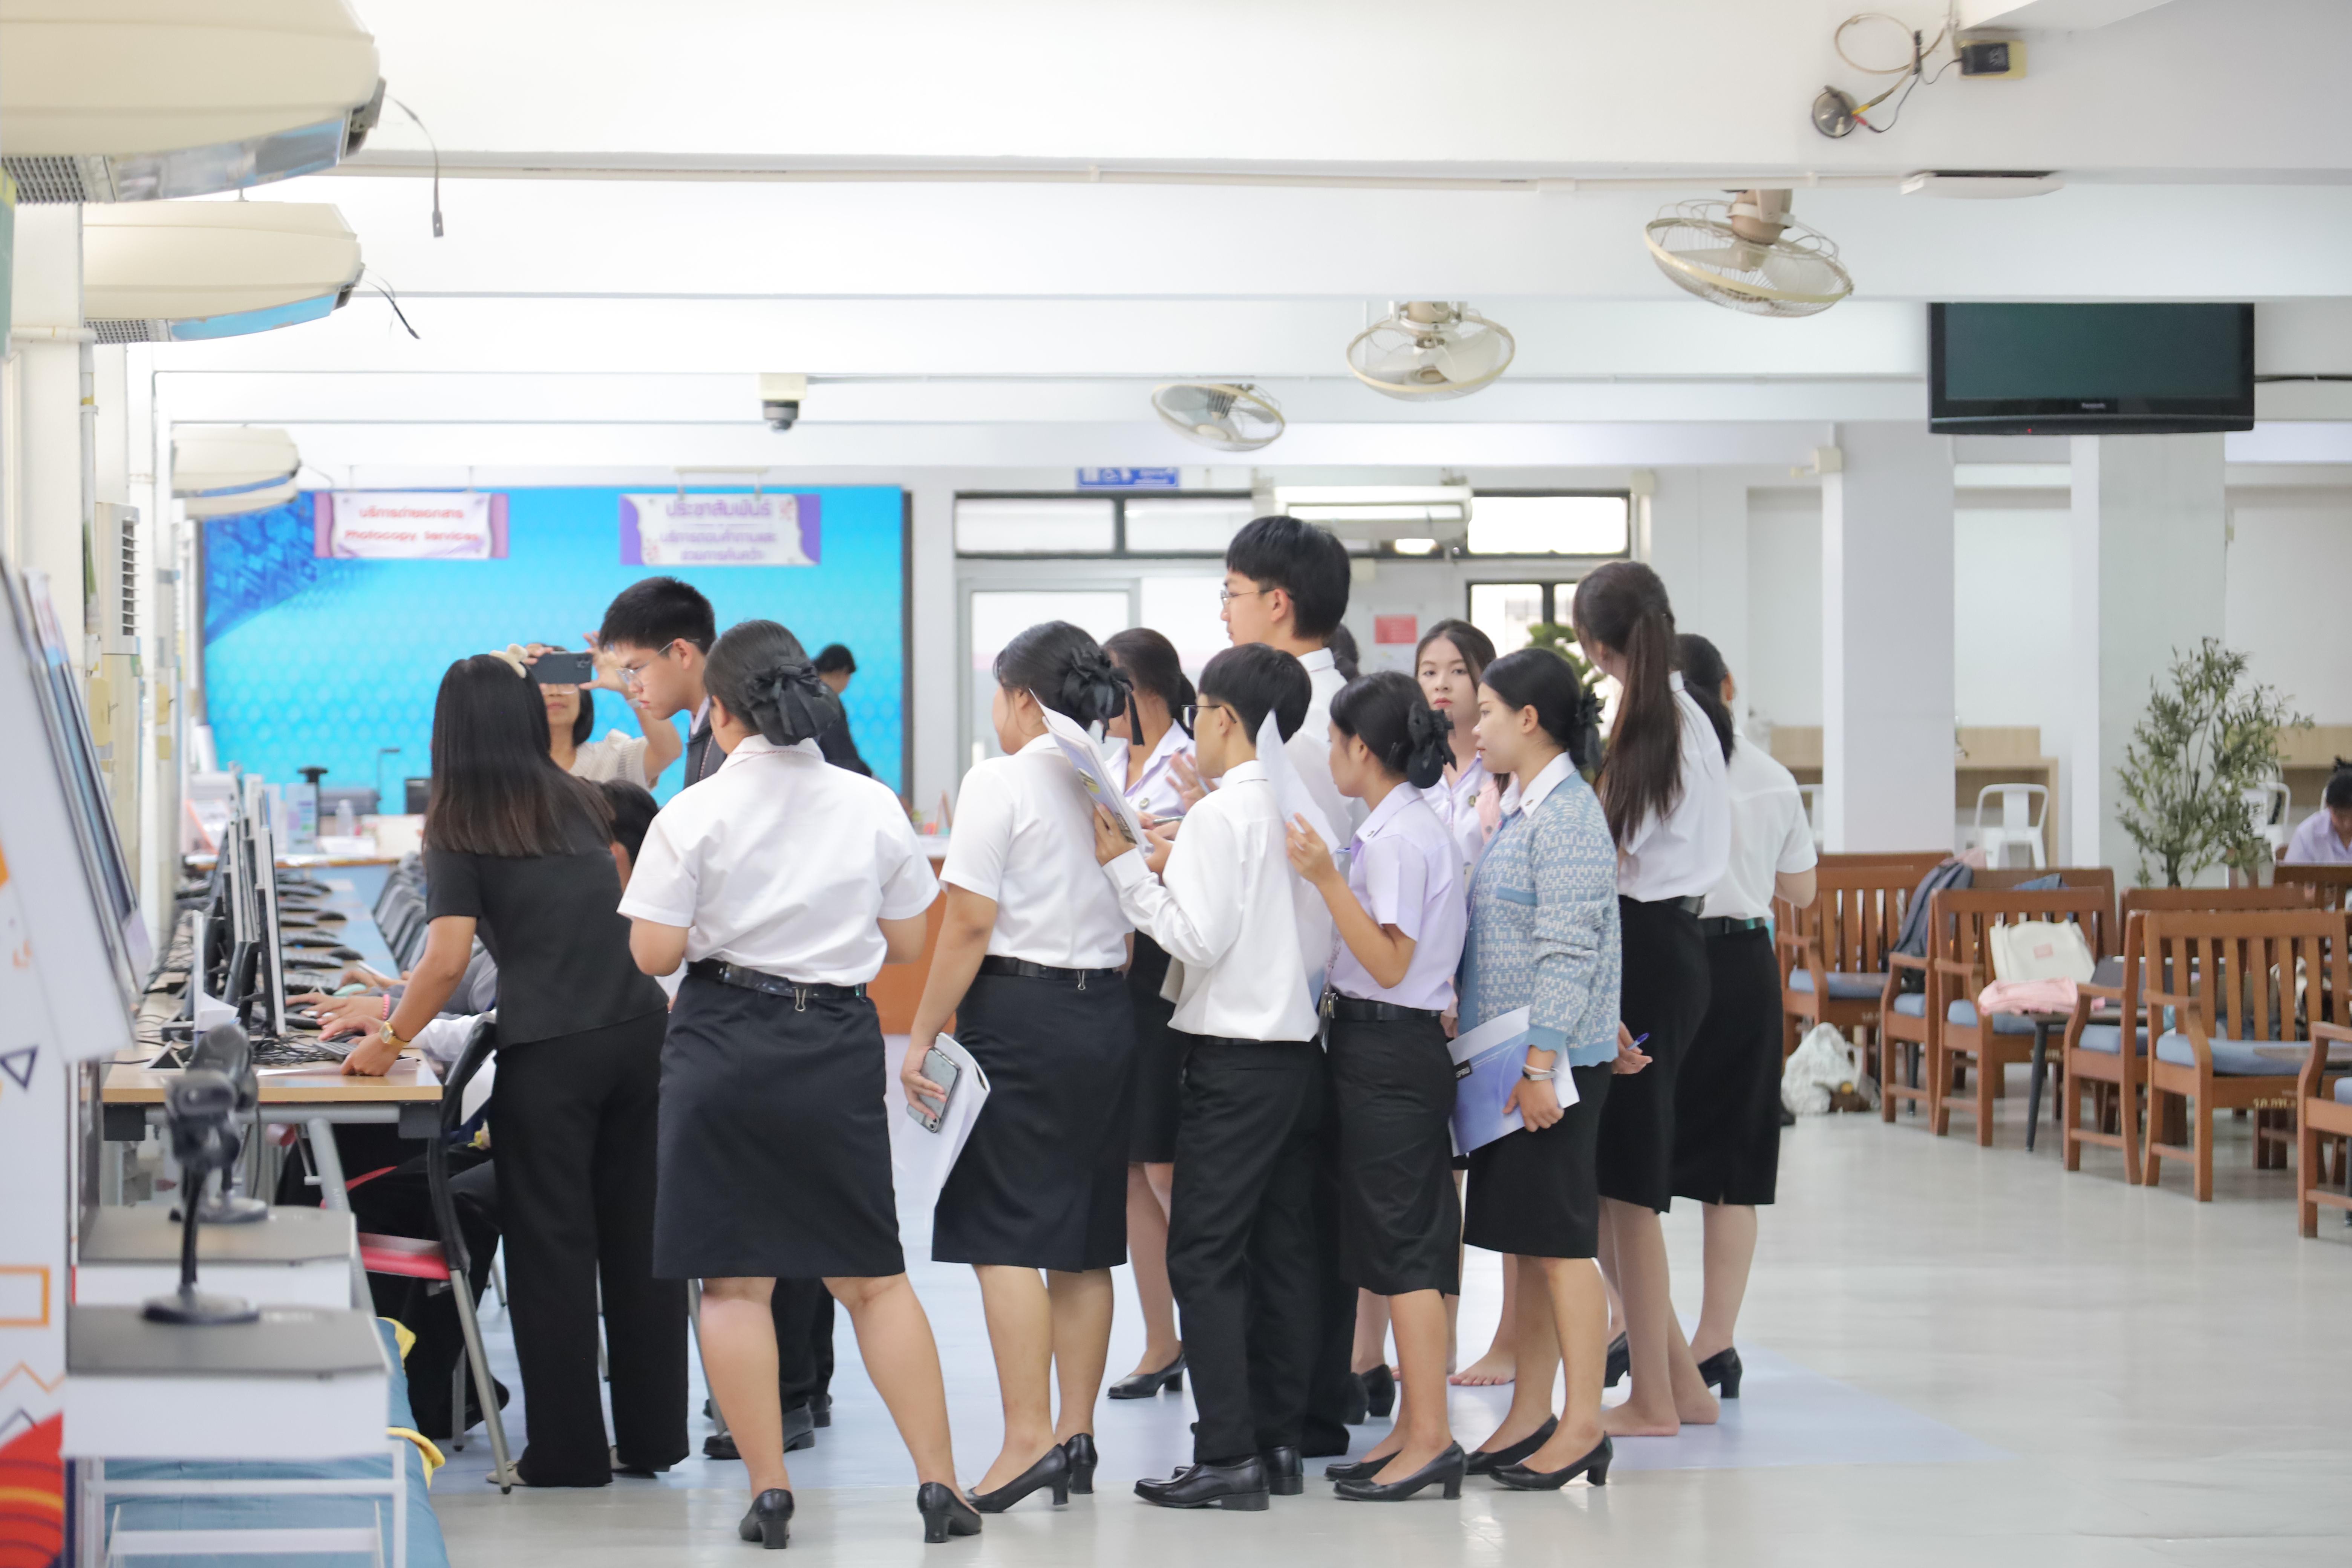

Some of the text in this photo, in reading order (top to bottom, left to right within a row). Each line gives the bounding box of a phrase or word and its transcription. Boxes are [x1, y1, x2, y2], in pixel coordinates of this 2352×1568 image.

[666, 499, 771, 516] ประชาสัมพันธ์
